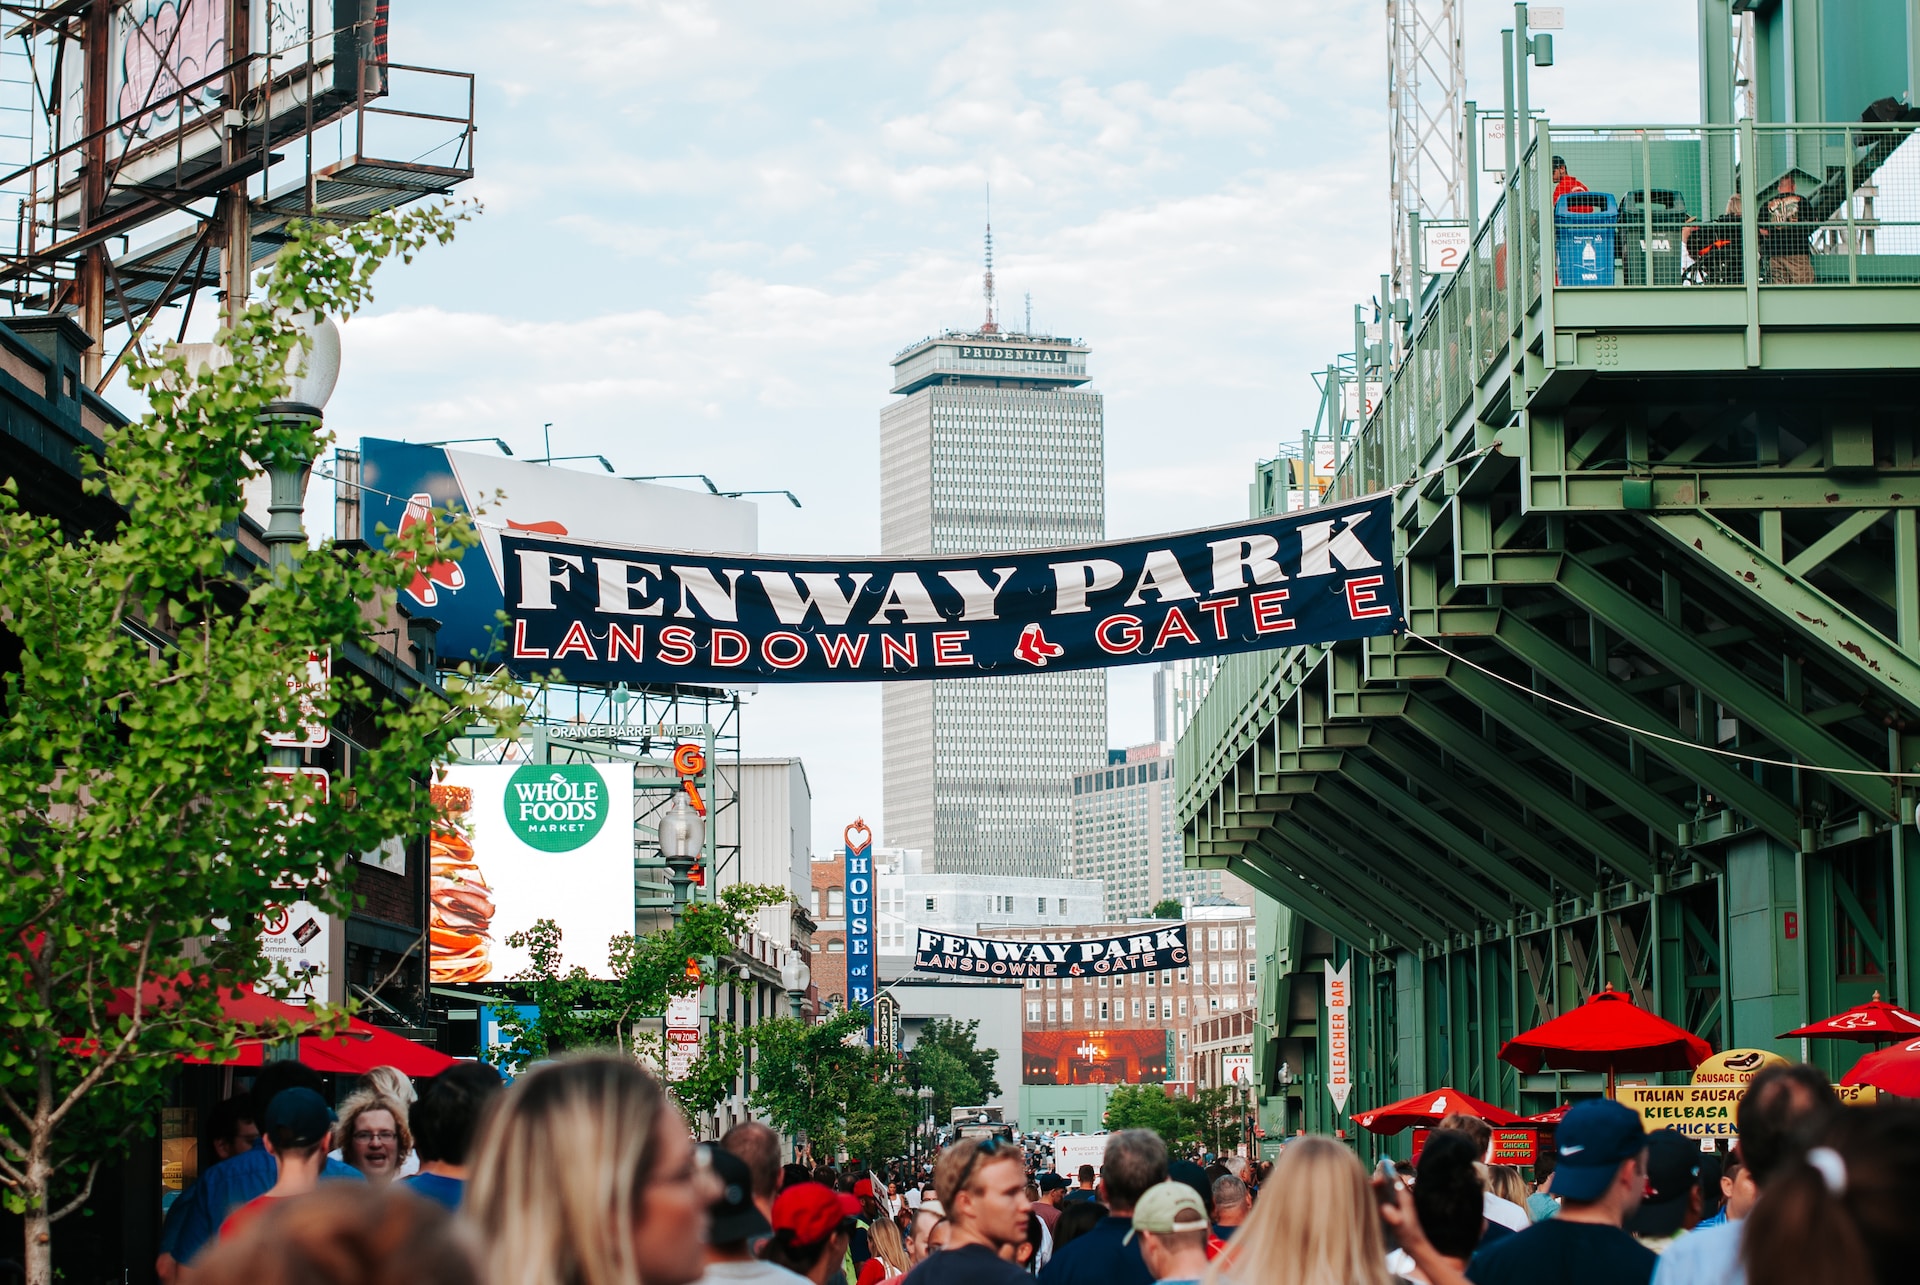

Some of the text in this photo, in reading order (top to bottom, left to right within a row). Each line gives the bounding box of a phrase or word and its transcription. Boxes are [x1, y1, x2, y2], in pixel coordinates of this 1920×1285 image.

[1440, 247, 1458, 267] 2
[963, 347, 1063, 361] PRUDENTIAL
[514, 510, 1383, 626] FENWAY PARK
[513, 575, 1392, 669] LANSDOWNE GATE E
[550, 724, 705, 738] ORANGE BARREL MEDIA
[514, 780, 599, 802] WHOLE
[519, 802, 597, 821] FOODS
[528, 824, 585, 832] MARKET
[850, 857, 869, 955] HOUSE
[1784, 912, 1798, 939] B
[264, 946, 307, 954] ommercial
[918, 928, 1185, 963] FENWAY PARK
[851, 964, 869, 976] of
[916, 948, 1188, 976] LANSDOWNE GATE C
[1332, 981, 1345, 1007] BAR
[682, 1033, 697, 1041] ZONE
[1332, 1013, 1345, 1084] BLEACHER
[1696, 1073, 1735, 1083] SAUSAGE
[1634, 1088, 1859, 1102] ITALIAN SAUSAG IPS
[1644, 1106, 1728, 1118] KIELBASA
